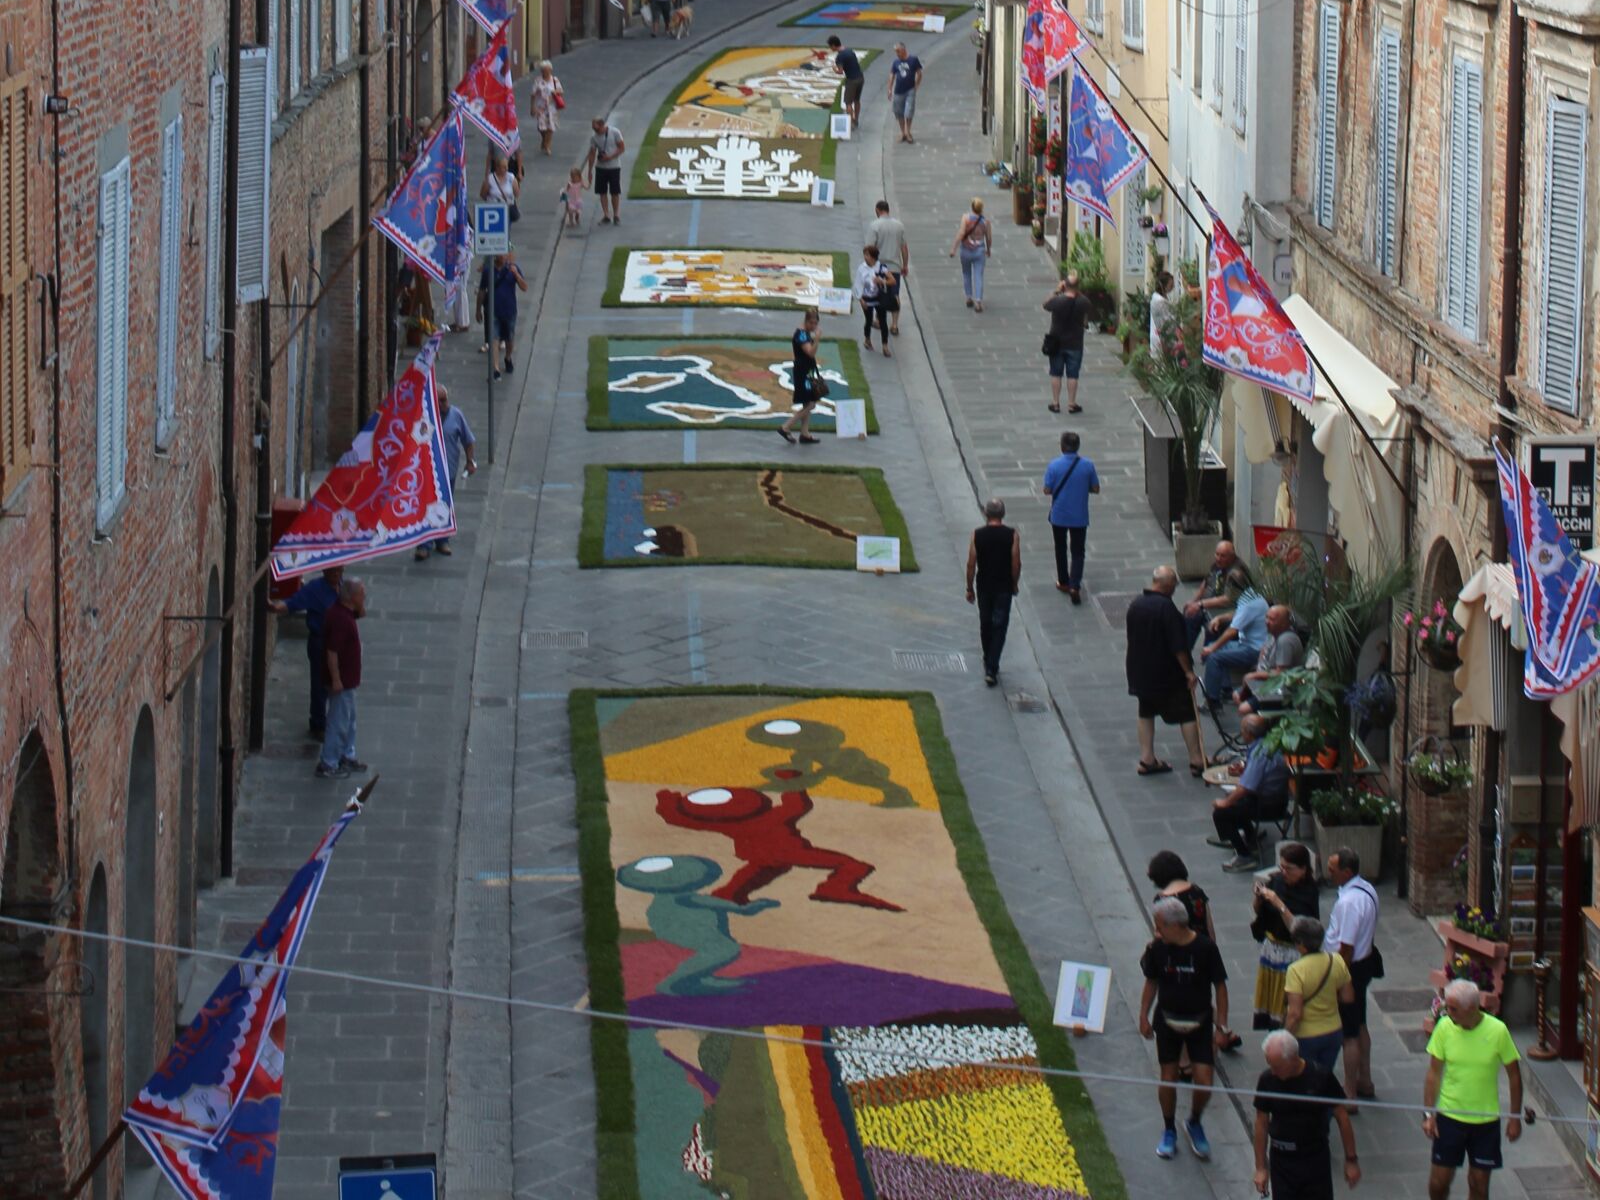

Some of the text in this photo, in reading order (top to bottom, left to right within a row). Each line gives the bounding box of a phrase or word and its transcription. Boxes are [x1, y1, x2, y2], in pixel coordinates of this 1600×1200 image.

[484, 210, 500, 231] P
[1540, 448, 1586, 506] T
[1549, 507, 1578, 516] ALI E
